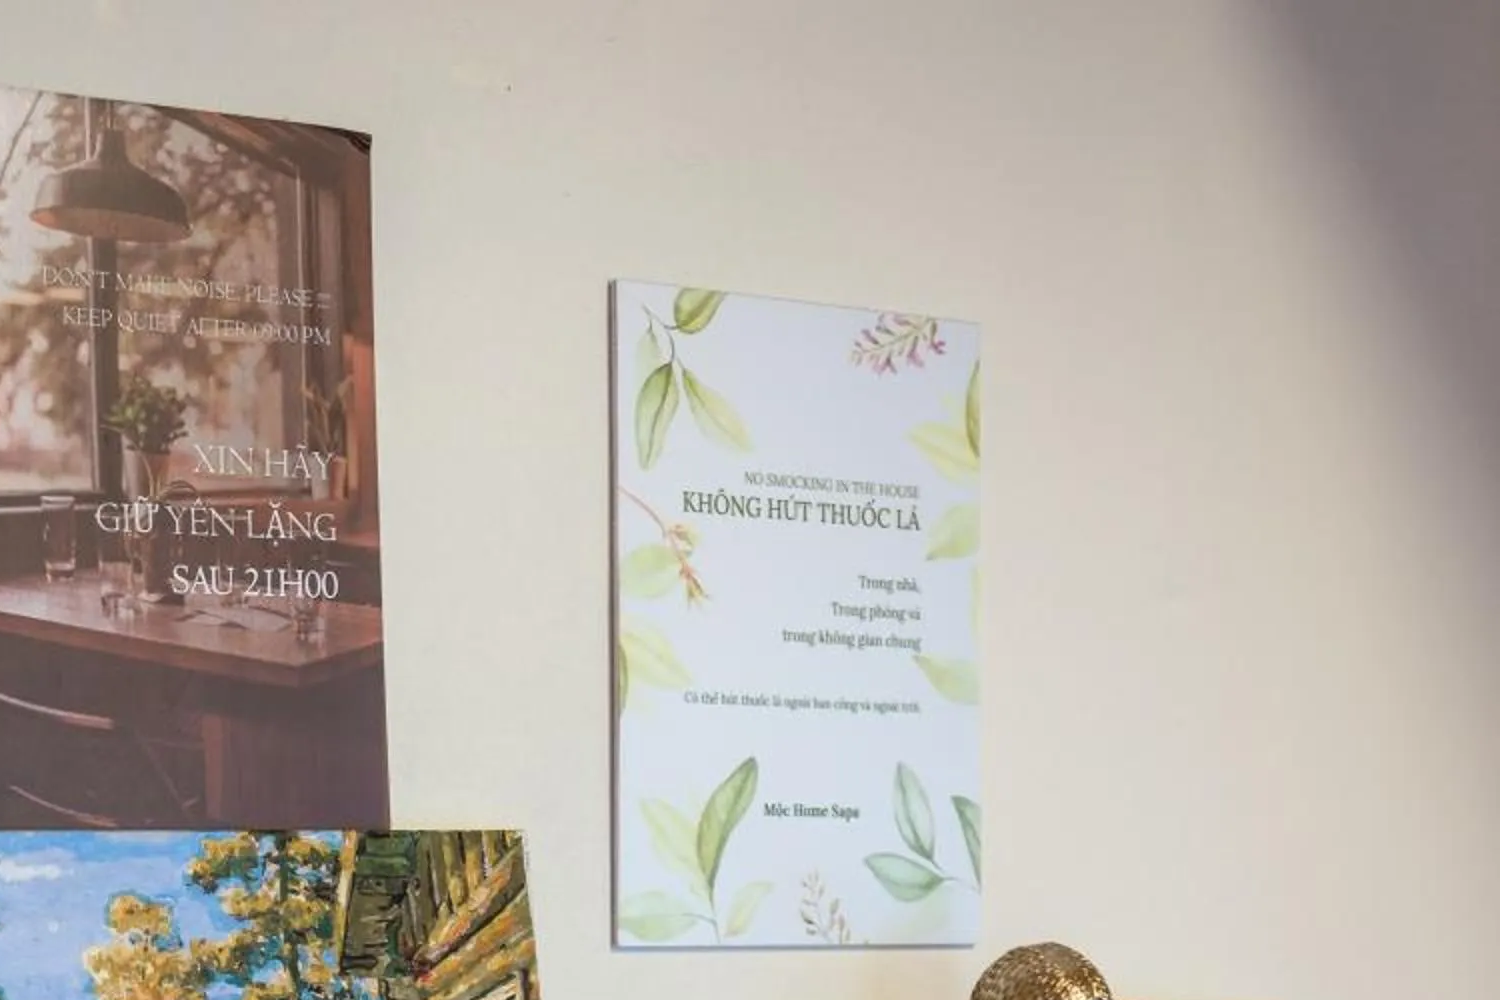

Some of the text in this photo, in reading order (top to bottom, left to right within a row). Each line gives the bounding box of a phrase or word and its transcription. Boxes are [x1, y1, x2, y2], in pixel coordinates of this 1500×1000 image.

[115, 272, 175, 296] MAKE
[245, 283, 314, 308] PLEASE
[62, 305, 113, 328] KEEP
[117, 309, 182, 335] QUIET
[187, 316, 246, 338] AFTER
[302, 324, 332, 347] PM
[194, 443, 334, 482] XIN HÃY
[744, 470, 920, 500] NO SMOCKING IN THE HOUSE
[94, 495, 338, 548] GIỮ YÊN LẶNG
[681, 487, 922, 531] KHÔNG HÚT THUỐC LÁ
[170, 564, 340, 600] SAU 21H00
[857, 574, 895, 595] Trong
[831, 601, 867, 621] Trong
[782, 629, 922, 655] trong không gian chung
[763, 802, 860, 824] Mộc Home Sapa
